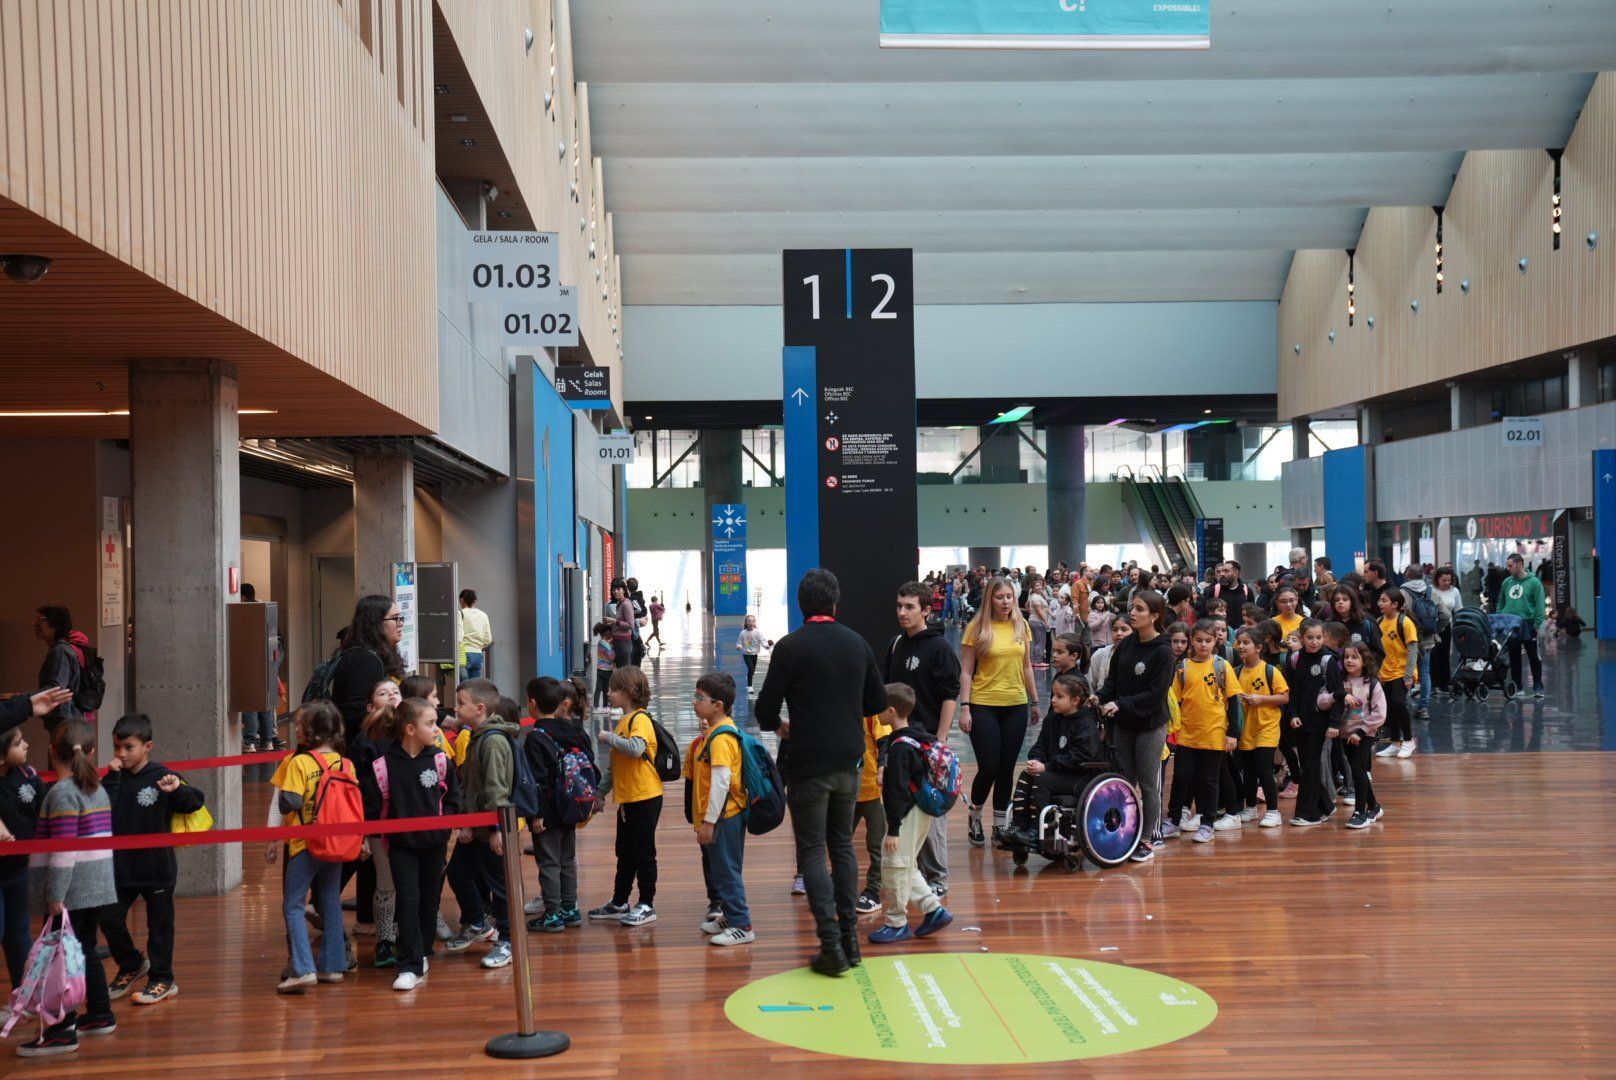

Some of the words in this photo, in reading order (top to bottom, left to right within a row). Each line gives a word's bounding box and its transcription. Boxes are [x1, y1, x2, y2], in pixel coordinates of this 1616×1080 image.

[1153, 4, 1200, 12] EXPOSSIBLE!
[473, 235, 492, 243] GELA
[500, 235, 518, 243] SALA
[525, 235, 549, 244] ROOM
[472, 263, 551, 289] 01.03
[803, 274, 820, 320] 1
[871, 273, 897, 319] 2
[504, 313, 572, 334] 01.02
[584, 388, 607, 396] Rooms
[1507, 430, 1540, 441] 02.01
[599, 448, 630, 458] 01.01
[1478, 514, 1533, 538] TURISMO
[1556, 536, 1565, 567] Estores
[1556, 570, 1566, 603] Bizkaia
